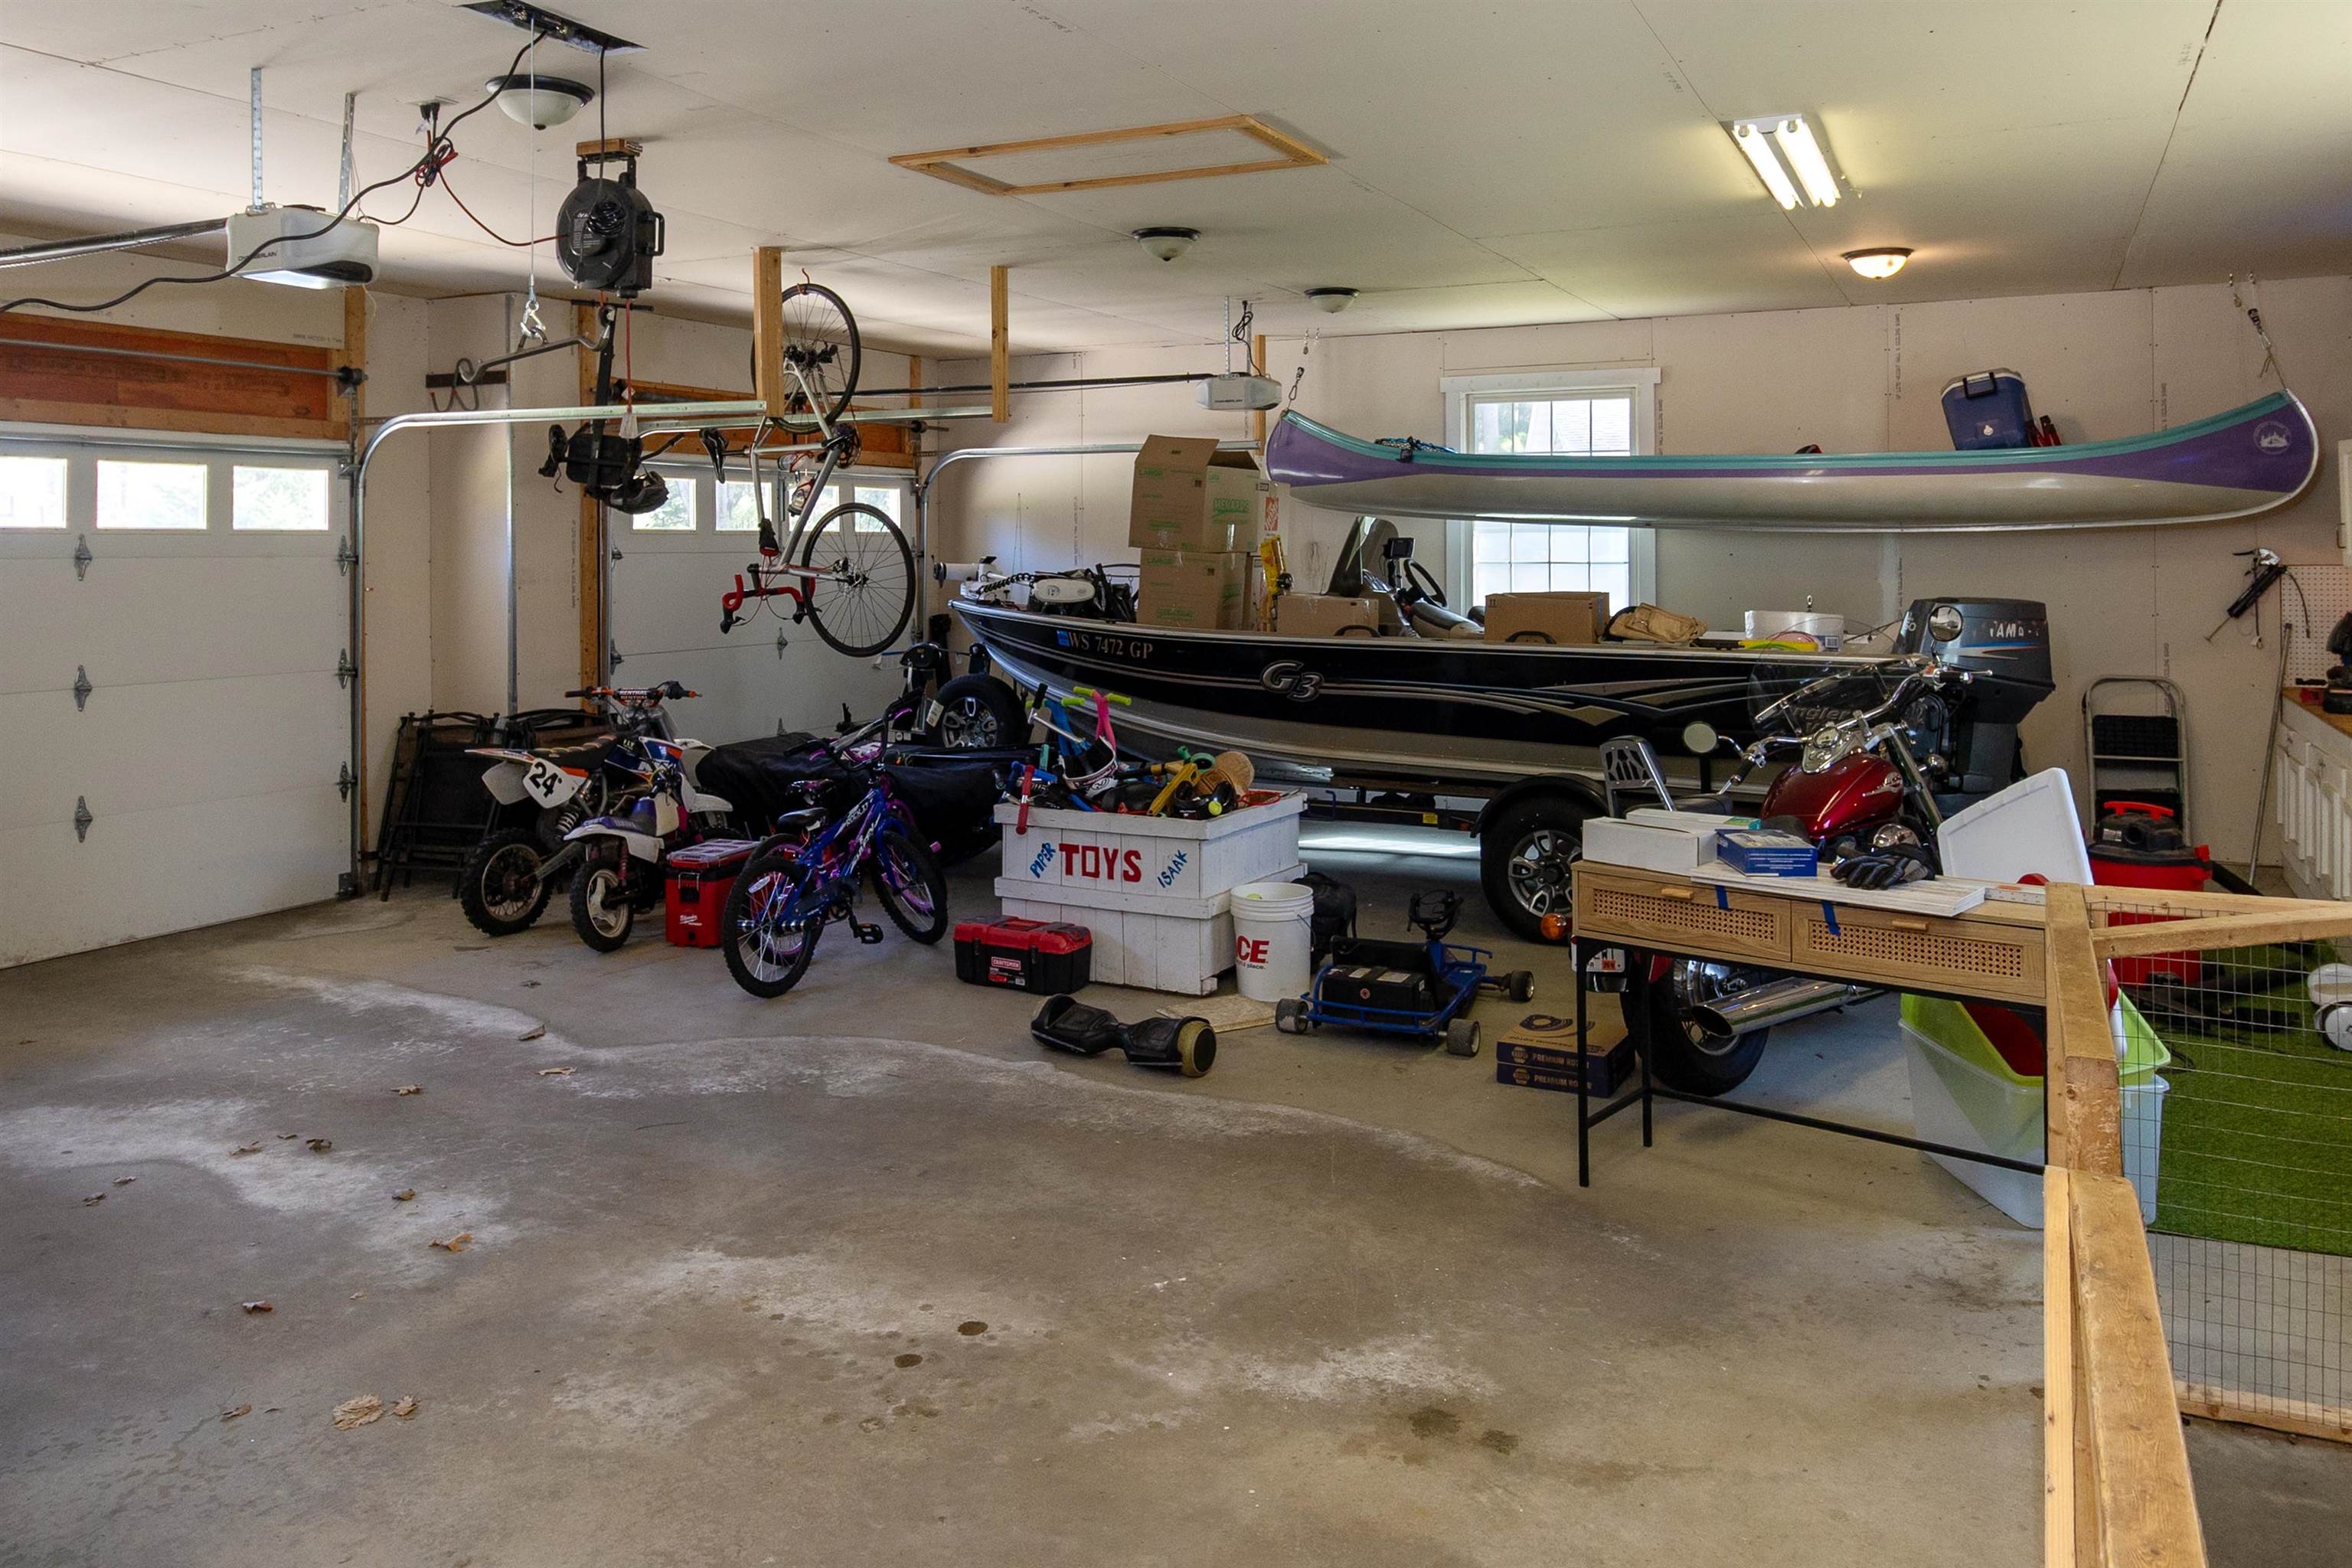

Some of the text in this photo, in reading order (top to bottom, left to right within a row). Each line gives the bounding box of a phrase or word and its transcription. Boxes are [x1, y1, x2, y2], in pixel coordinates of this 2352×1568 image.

[1068, 632, 1089, 650] WS
[1095, 636, 1124, 655] 7472
[1129, 641, 1153, 659] GP
[1259, 660, 1325, 702] G3
[1793, 707, 1851, 721] ngler
[529, 762, 559, 799] 24
[1030, 842, 1056, 879] PIPER
[1059, 843, 1142, 882] TOYS
[1157, 849, 1187, 888] ISAAK
[1235, 935, 1269, 964] CE
